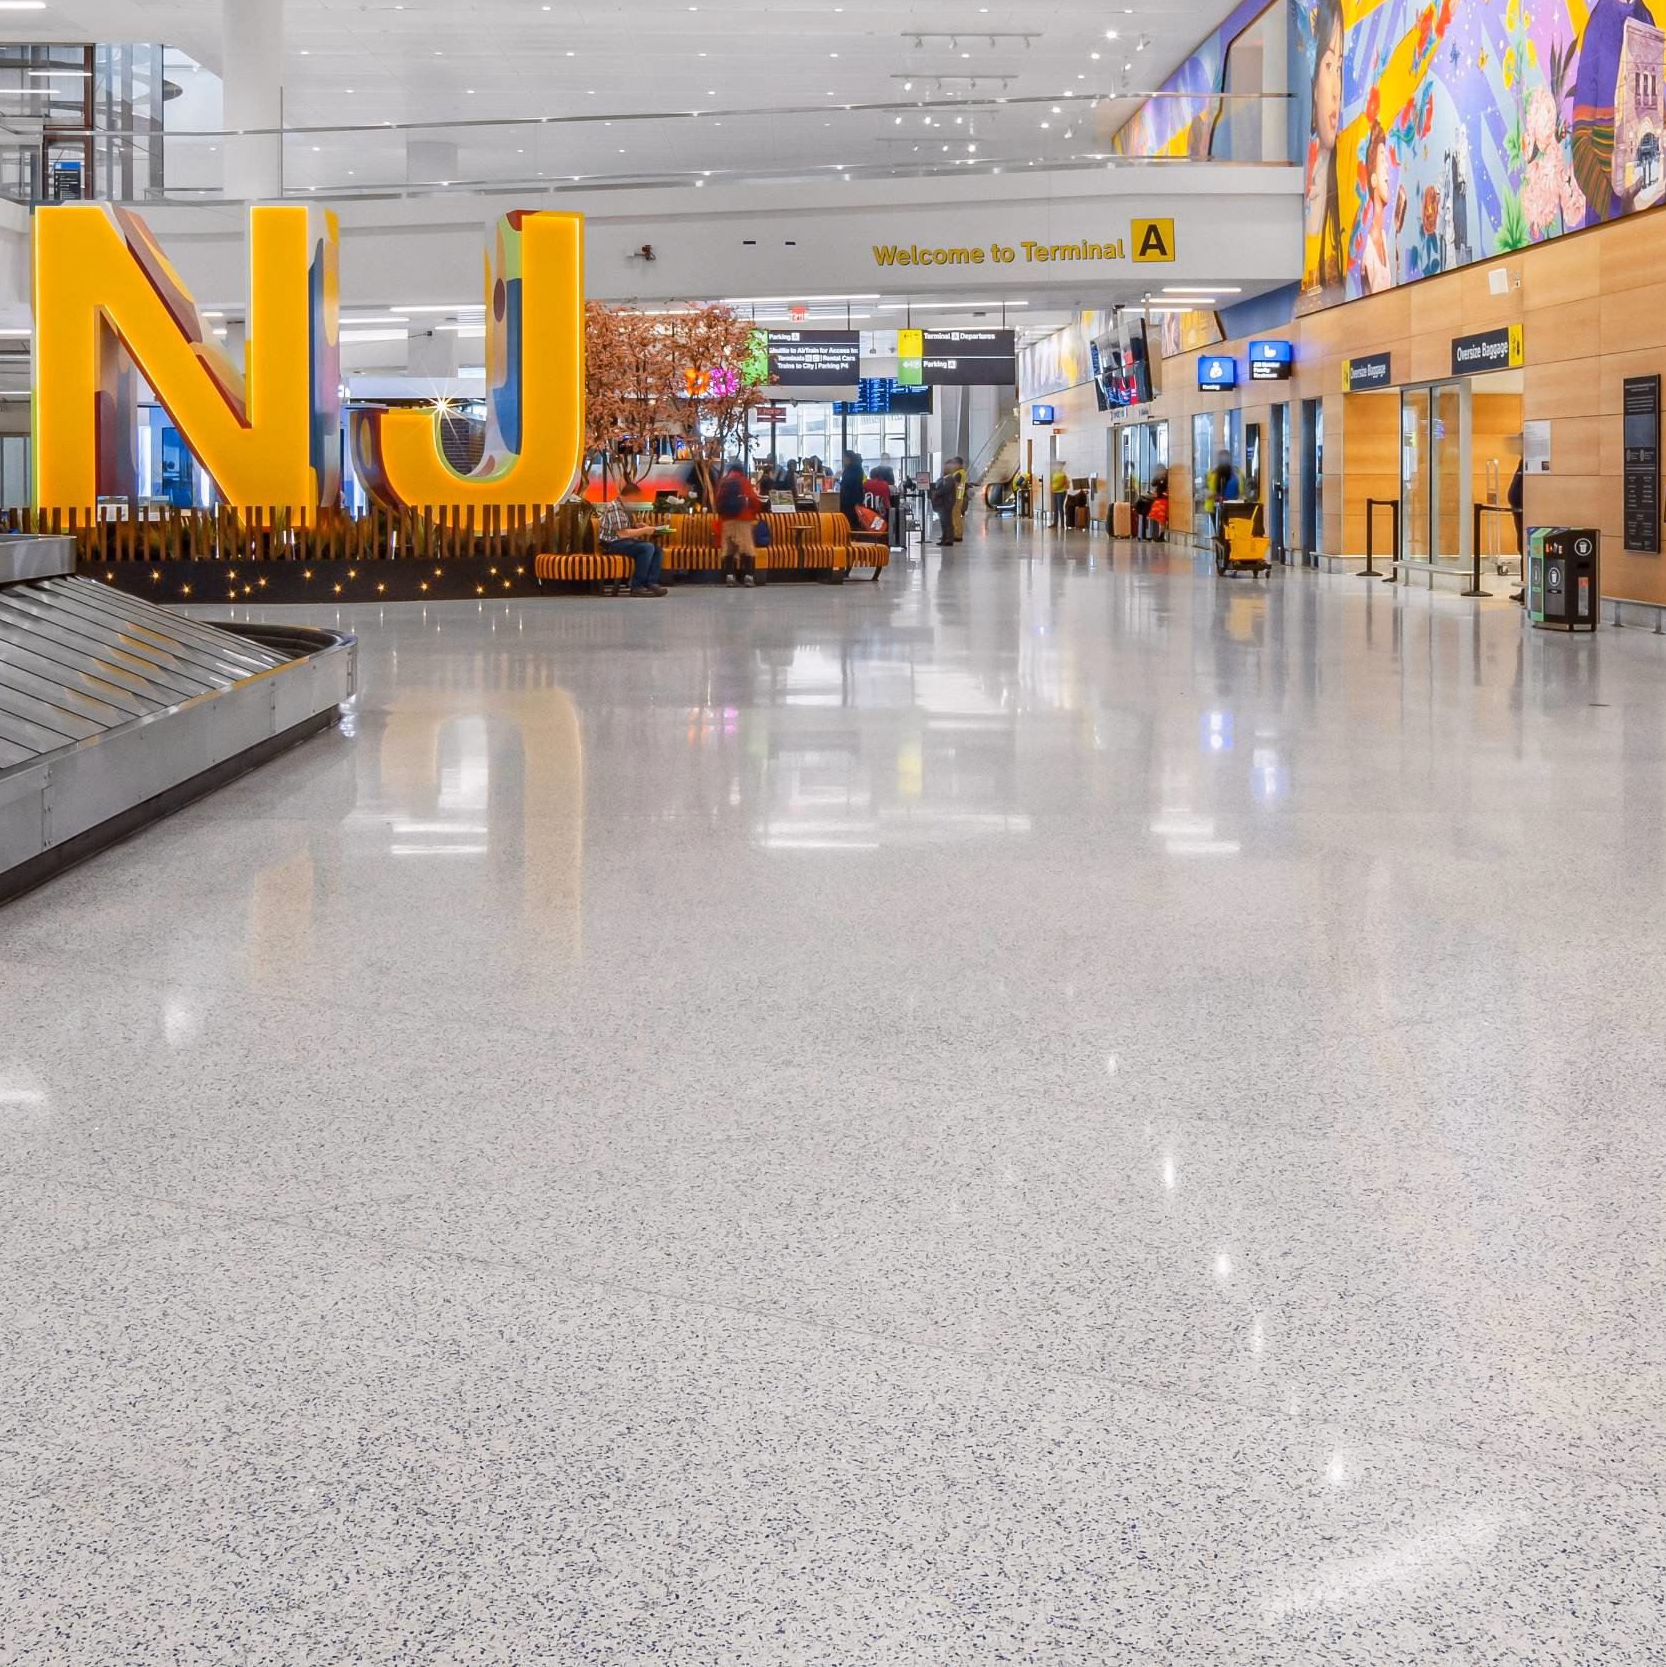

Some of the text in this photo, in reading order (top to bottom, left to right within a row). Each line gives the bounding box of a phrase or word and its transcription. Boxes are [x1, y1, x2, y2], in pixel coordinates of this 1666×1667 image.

[873, 223, 1168, 266] Welcome to Terminal A
[960, 333, 995, 341] Departures
[1457, 341, 1508, 361] Oversize Baggage
[923, 361, 947, 369] Parking
[1367, 363, 1385, 378] Baggage
